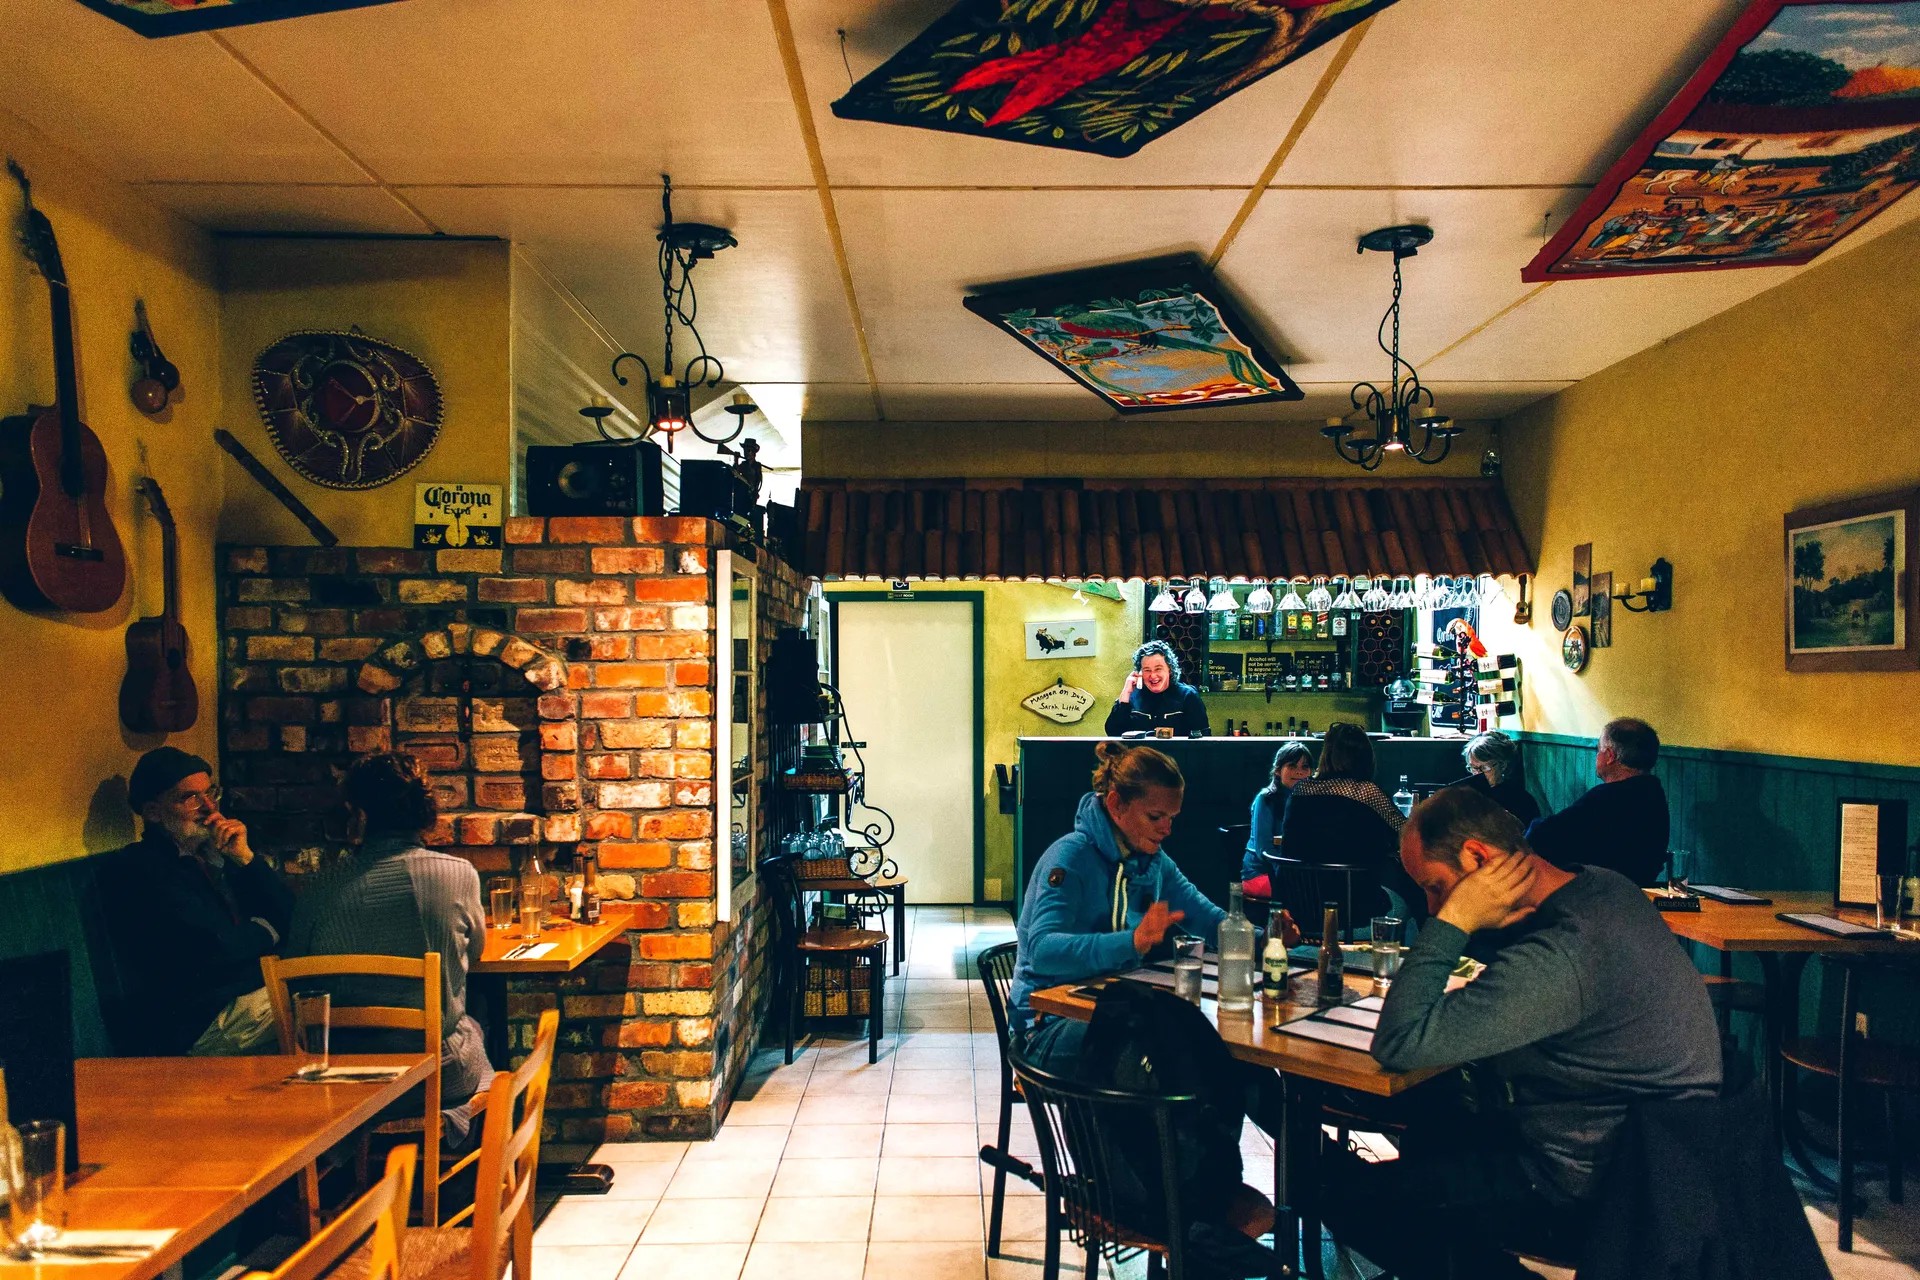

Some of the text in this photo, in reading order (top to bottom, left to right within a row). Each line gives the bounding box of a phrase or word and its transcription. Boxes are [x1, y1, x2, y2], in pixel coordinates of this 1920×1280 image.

[424, 486, 491, 509] Corona
[444, 505, 471, 515] Extra
[1071, 691, 1088, 705] Duty
[1039, 702, 1081, 711] Sarah Little
